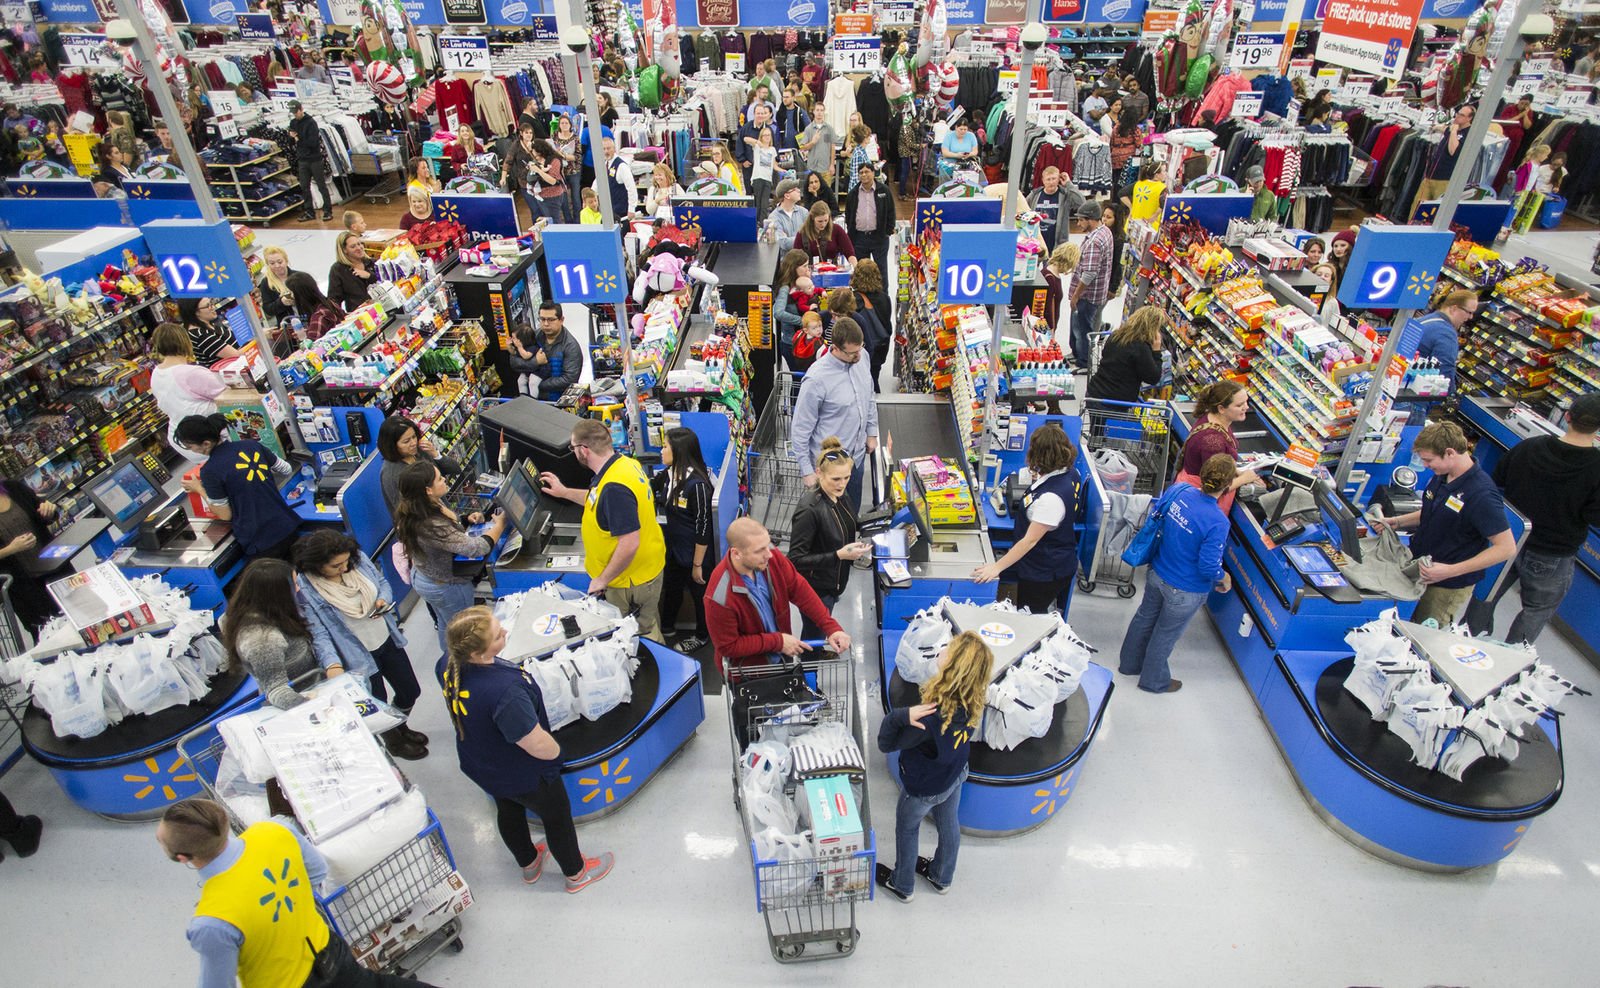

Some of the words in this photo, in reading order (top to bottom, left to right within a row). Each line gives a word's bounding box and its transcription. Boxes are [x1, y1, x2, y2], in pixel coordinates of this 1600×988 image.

[52, 3, 88, 12] Juniors
[1328, 2, 1350, 20] FREE
[1346, 5, 1366, 25] pick
[1365, 11, 1378, 29] up
[1377, 11, 1389, 27] at
[1387, 12, 1412, 31] store
[1339, 43, 1358, 56] Walmart
[1357, 48, 1368, 59] App
[702, 200, 748, 208] BENTONVILLE
[162, 255, 208, 290] 12
[555, 263, 589, 295] 11
[946, 263, 984, 297] 10
[1368, 265, 1398, 301] 9
